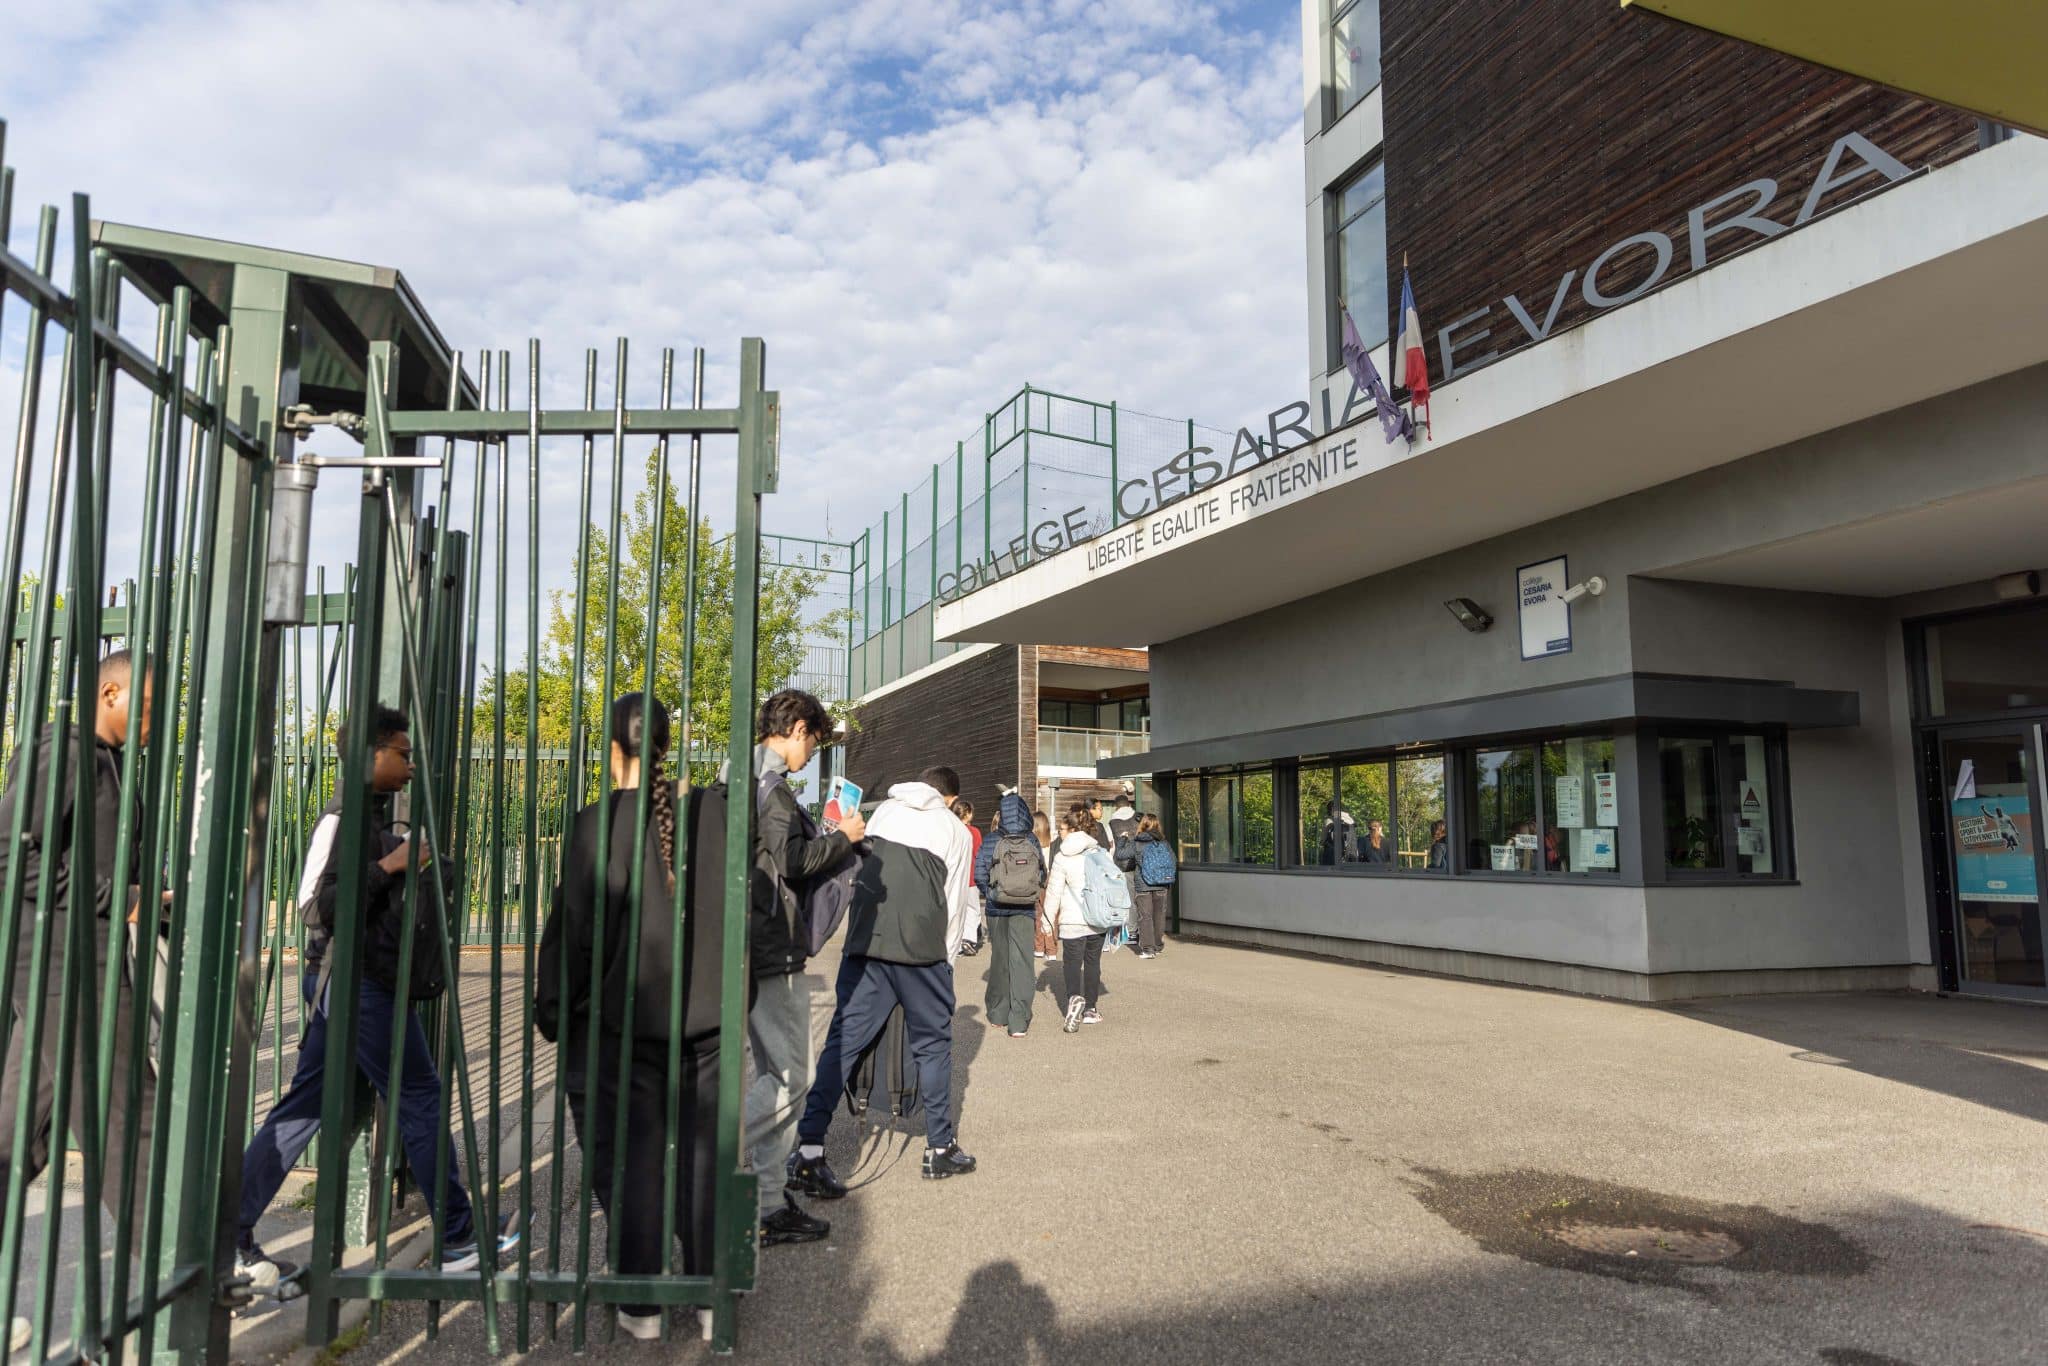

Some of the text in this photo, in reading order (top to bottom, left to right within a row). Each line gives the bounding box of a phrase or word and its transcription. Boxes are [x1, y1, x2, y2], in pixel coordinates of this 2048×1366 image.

[937, 130, 1914, 602] COLLEGE CESARIA EVORA
[1087, 438, 1359, 572] LIBERTE EGALITE FRATERNITE
[1524, 594, 1547, 606] EVORA
